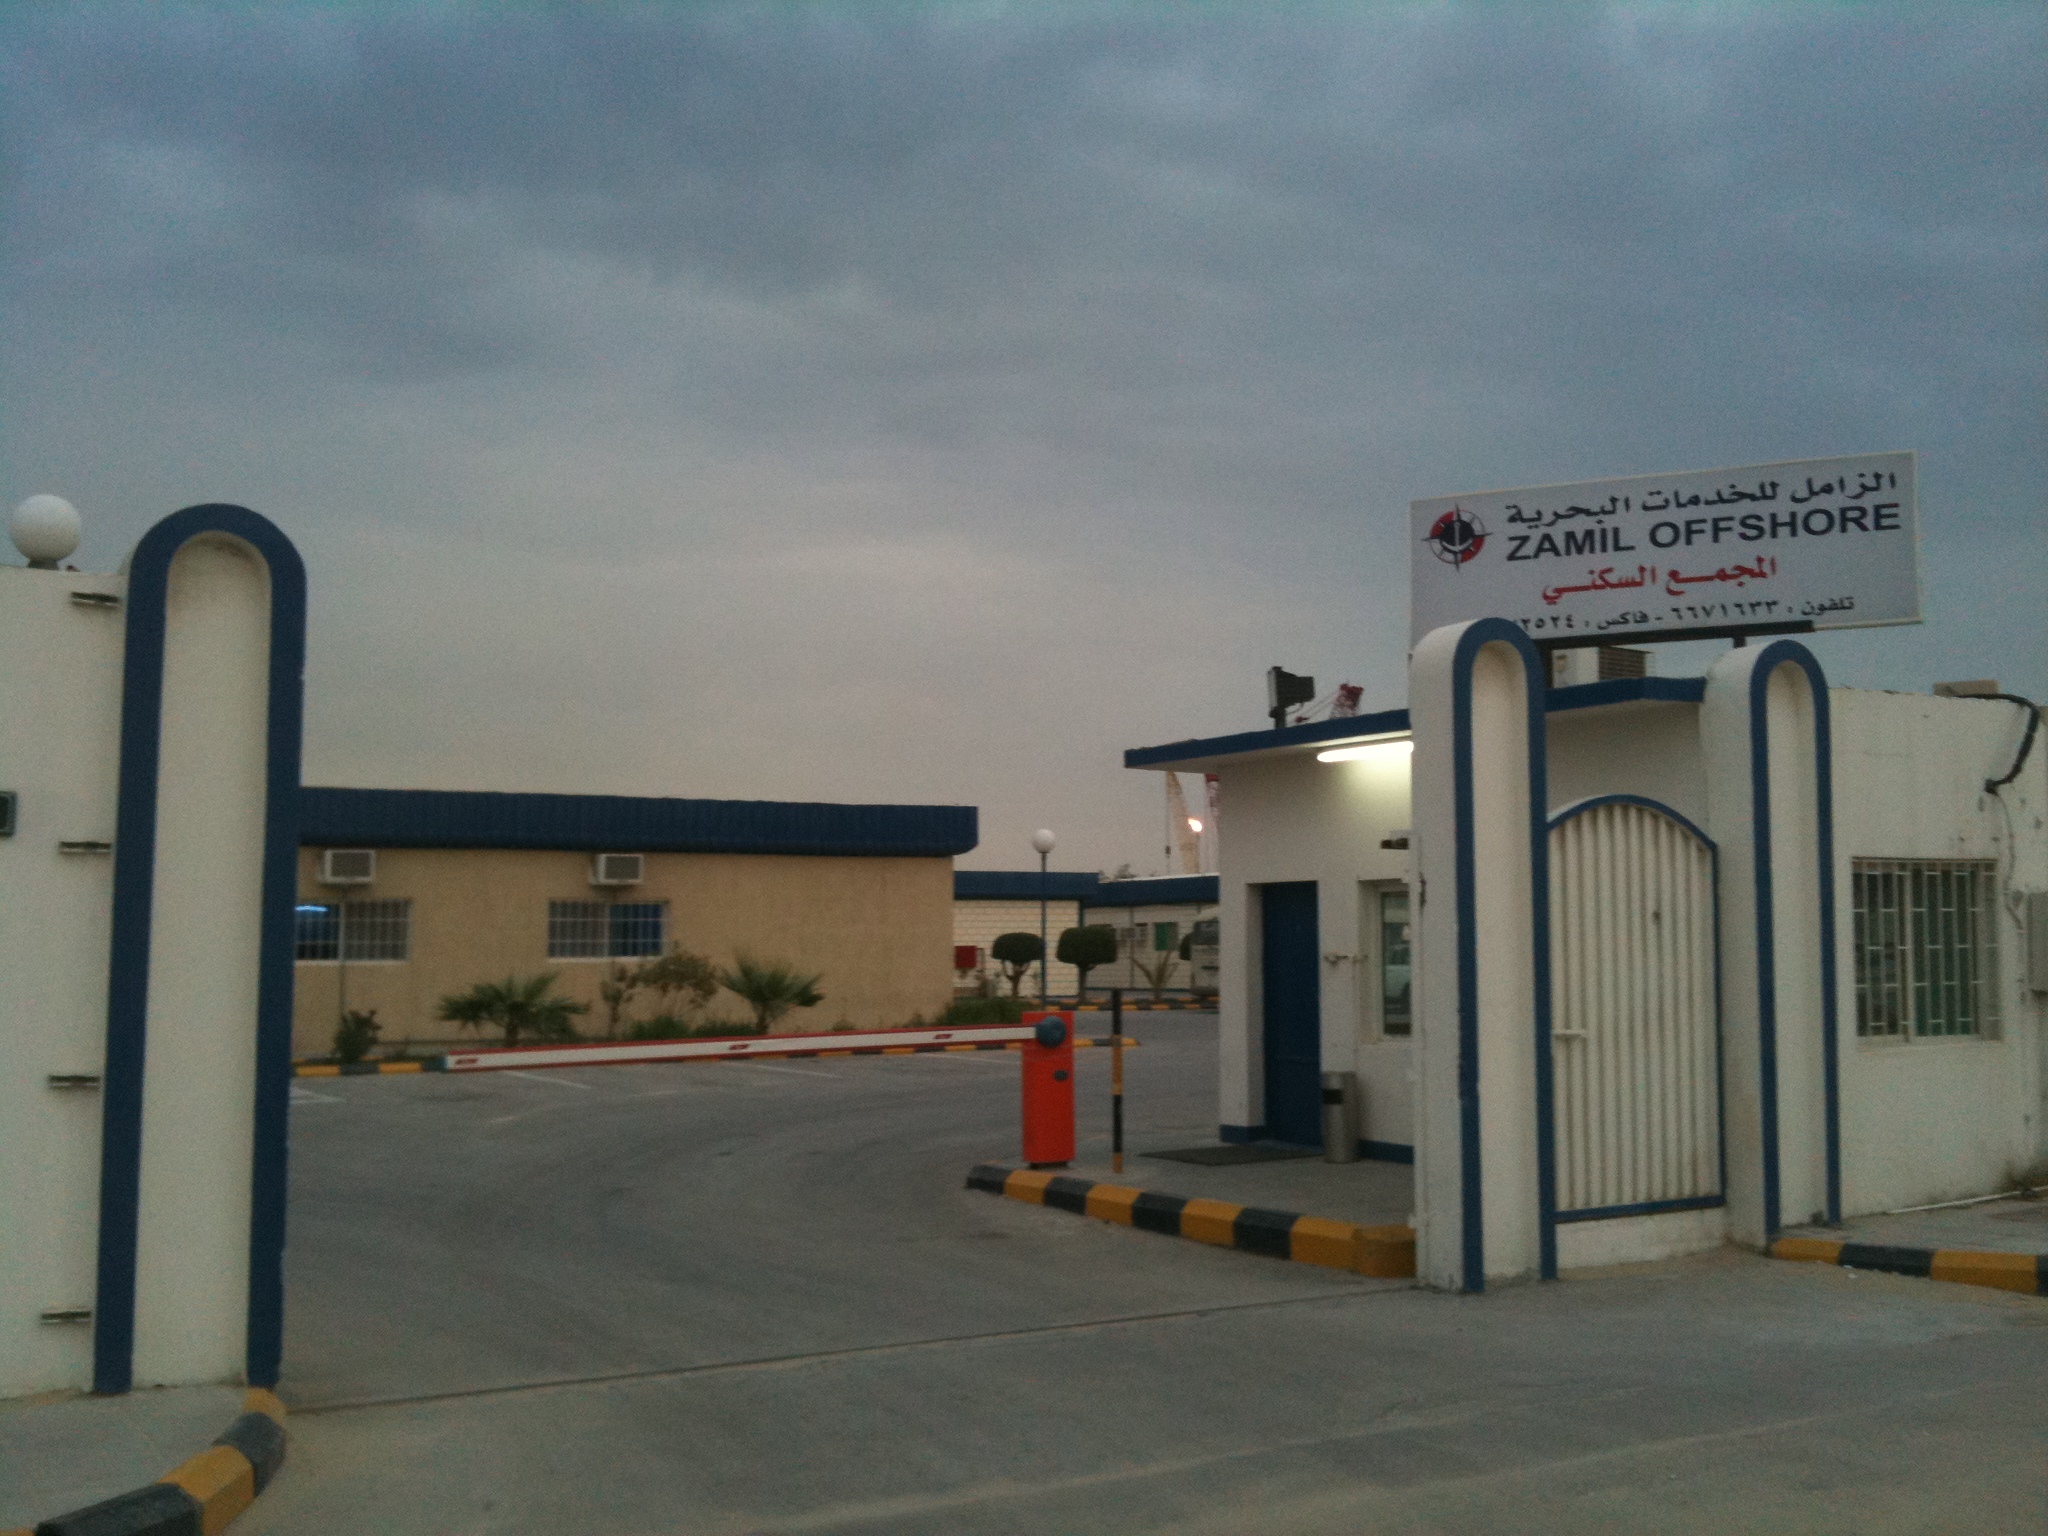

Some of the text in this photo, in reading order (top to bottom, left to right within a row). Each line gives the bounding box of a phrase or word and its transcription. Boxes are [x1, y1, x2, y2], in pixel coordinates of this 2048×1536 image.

[1505, 471, 1896, 528] الزامل للخدمات البحرية
[1506, 502, 1901, 562] ZAMIL OFFSHORE
[1542, 554, 1777, 606] المجمع السكني
